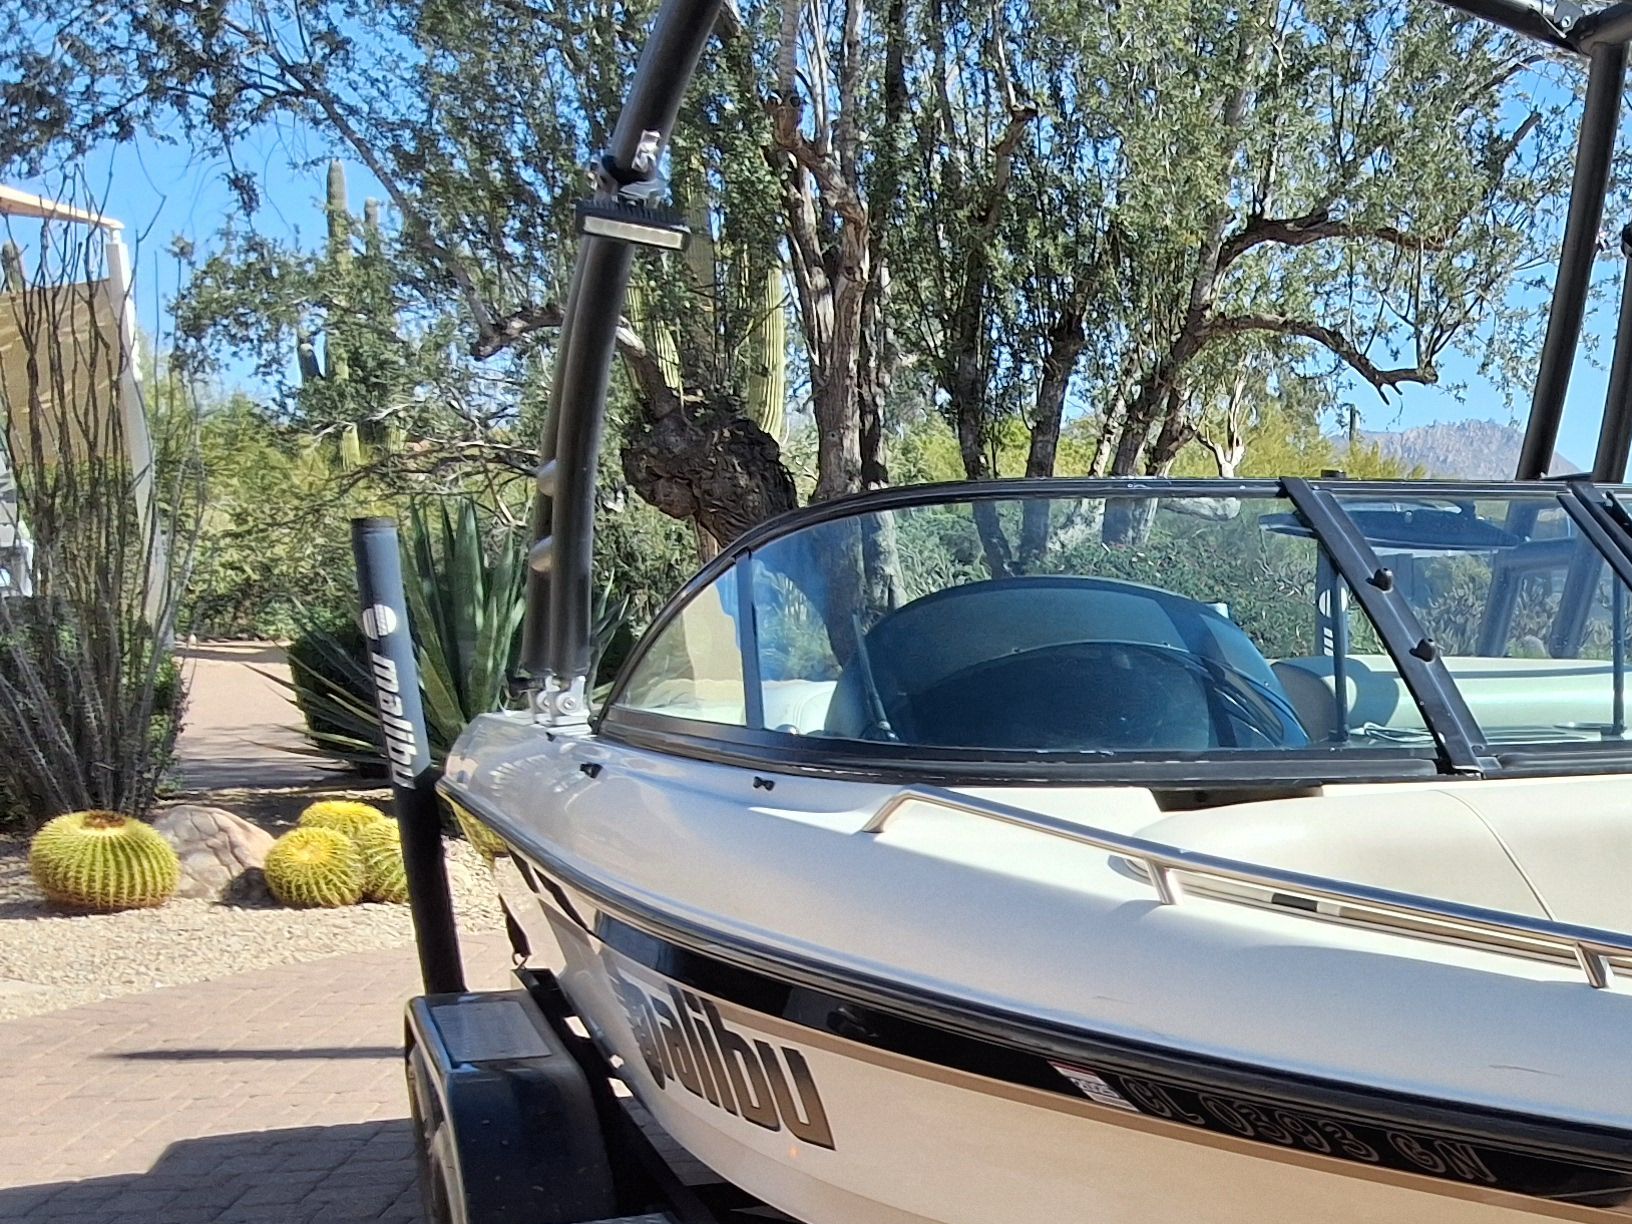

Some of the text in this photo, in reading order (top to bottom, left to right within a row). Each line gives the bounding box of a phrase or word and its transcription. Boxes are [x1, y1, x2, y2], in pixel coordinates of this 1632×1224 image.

[372, 652, 417, 790] malibu
[1119, 1076, 1206, 1125] CL
[1198, 1093, 1380, 1162] 0393
[1386, 1130, 1497, 1183] GN
